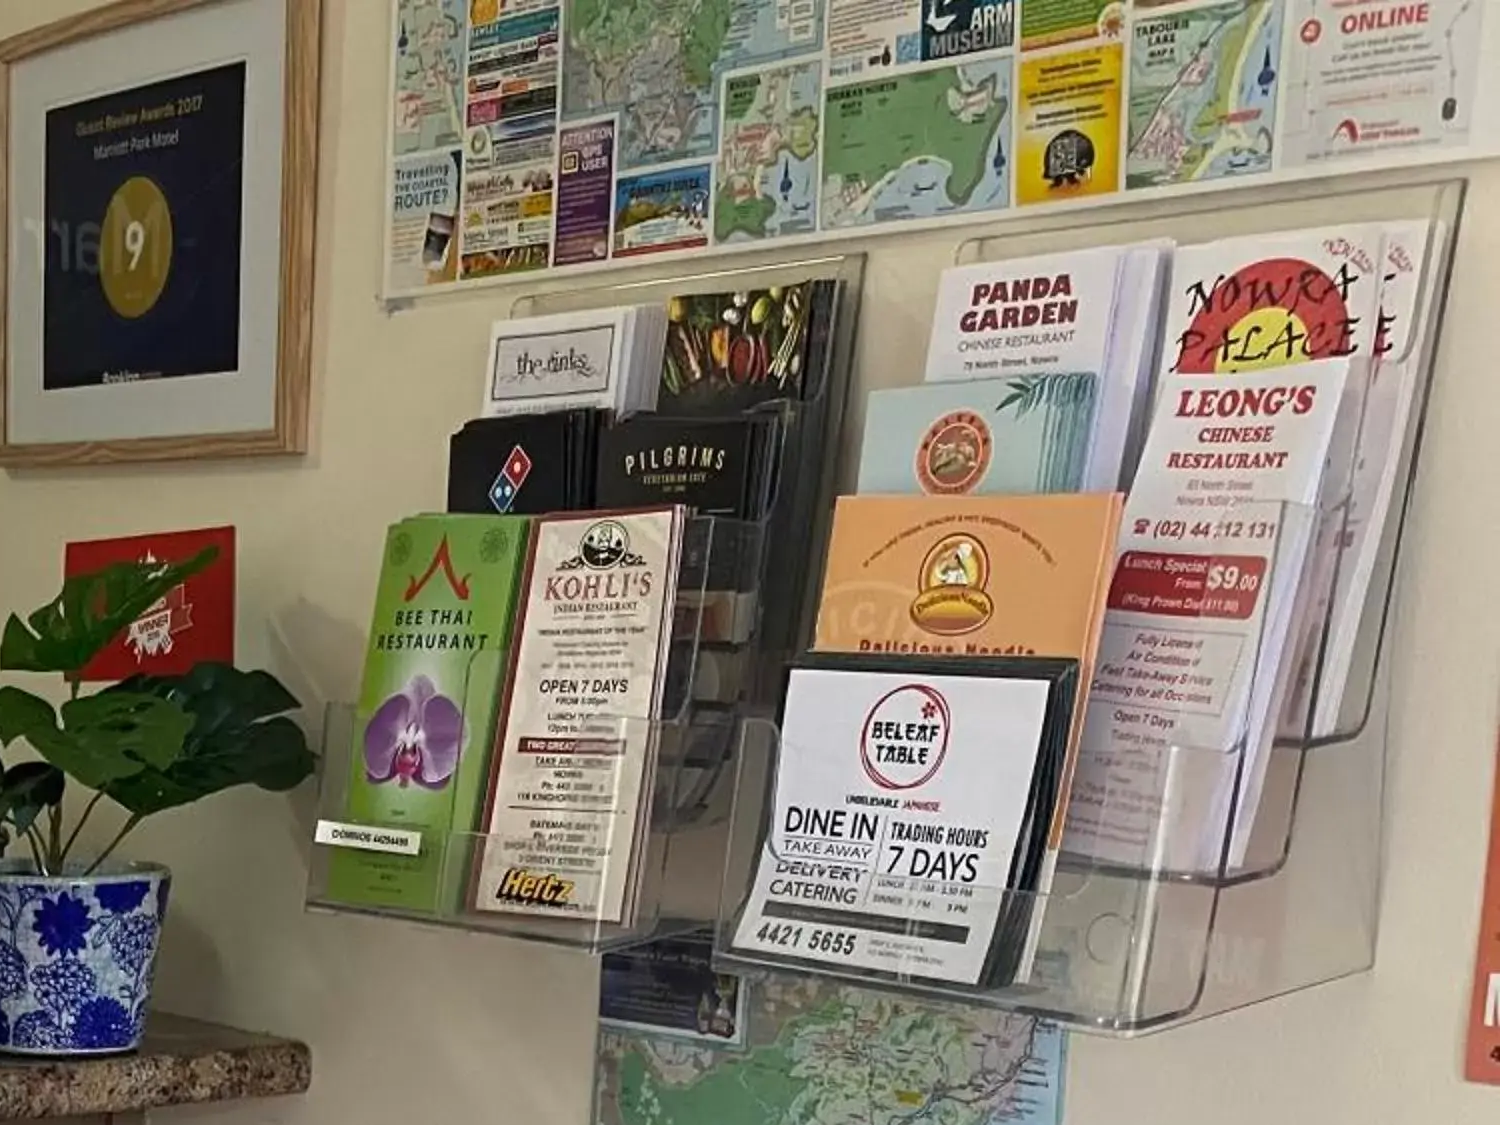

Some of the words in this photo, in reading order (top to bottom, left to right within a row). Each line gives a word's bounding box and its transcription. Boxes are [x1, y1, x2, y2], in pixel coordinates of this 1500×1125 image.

[971, 2, 1012, 30] ARM
[1341, 3, 1429, 35] ONLINE
[930, 22, 1012, 58] MUSEUM
[105, 113, 138, 131] Review
[562, 127, 613, 147] ATTENTION
[395, 165, 450, 181] Travelling
[581, 156, 608, 172] USER
[395, 189, 449, 211] ROUTE?
[126, 220, 145, 271] 9
[972, 274, 1072, 307] PANDA
[1186, 263, 1359, 316] NOWRA
[959, 300, 1079, 334] GARDEN
[958, 337, 1003, 353] CHINESE
[1005, 330, 1077, 348] RESTAURANT
[1169, 316, 1361, 373] PALACE
[1175, 386, 1317, 419] LEONG'S
[1198, 427, 1275, 444] CHINESE
[624, 445, 726, 477] PILGRIMS
[1167, 452, 1289, 470] RESTAURANT
[1153, 519, 1186, 540] (02)
[1190, 519, 1211, 538] 44
[1249, 522, 1276, 540] 131
[1124, 555, 1163, 572] Lunch
[1165, 557, 1207, 574] Special
[544, 571, 653, 601] KOHLI'S
[1207, 564, 1258, 592] $9.00
[395, 608, 423, 626] BEE
[430, 609, 474, 626] THAI
[553, 604, 584, 615] INDIAN
[585, 600, 638, 613] RESTAURANT
[376, 633, 489, 651] RESTAURANT
[539, 678, 581, 694] OPEN
[581, 678, 590, 694] 7
[592, 678, 629, 694] DAYS
[1113, 709, 1141, 723] Open
[1150, 715, 1174, 730] Days
[872, 720, 940, 743] BELEAF
[875, 744, 930, 766] TABLE
[785, 806, 846, 839] DINE
[850, 812, 879, 841] IN
[891, 822, 944, 845] TRADING
[946, 827, 990, 849] HOURS
[784, 840, 821, 855] TAKE
[823, 842, 873, 859] AWAY
[775, 861, 869, 884] DELIVERY
[886, 845, 905, 874] 7
[909, 848, 980, 883] DAYS
[498, 868, 576, 904] Hertz
[769, 879, 858, 905] CATERING
[756, 921, 804, 946] 4421
[807, 929, 857, 956] 5655
